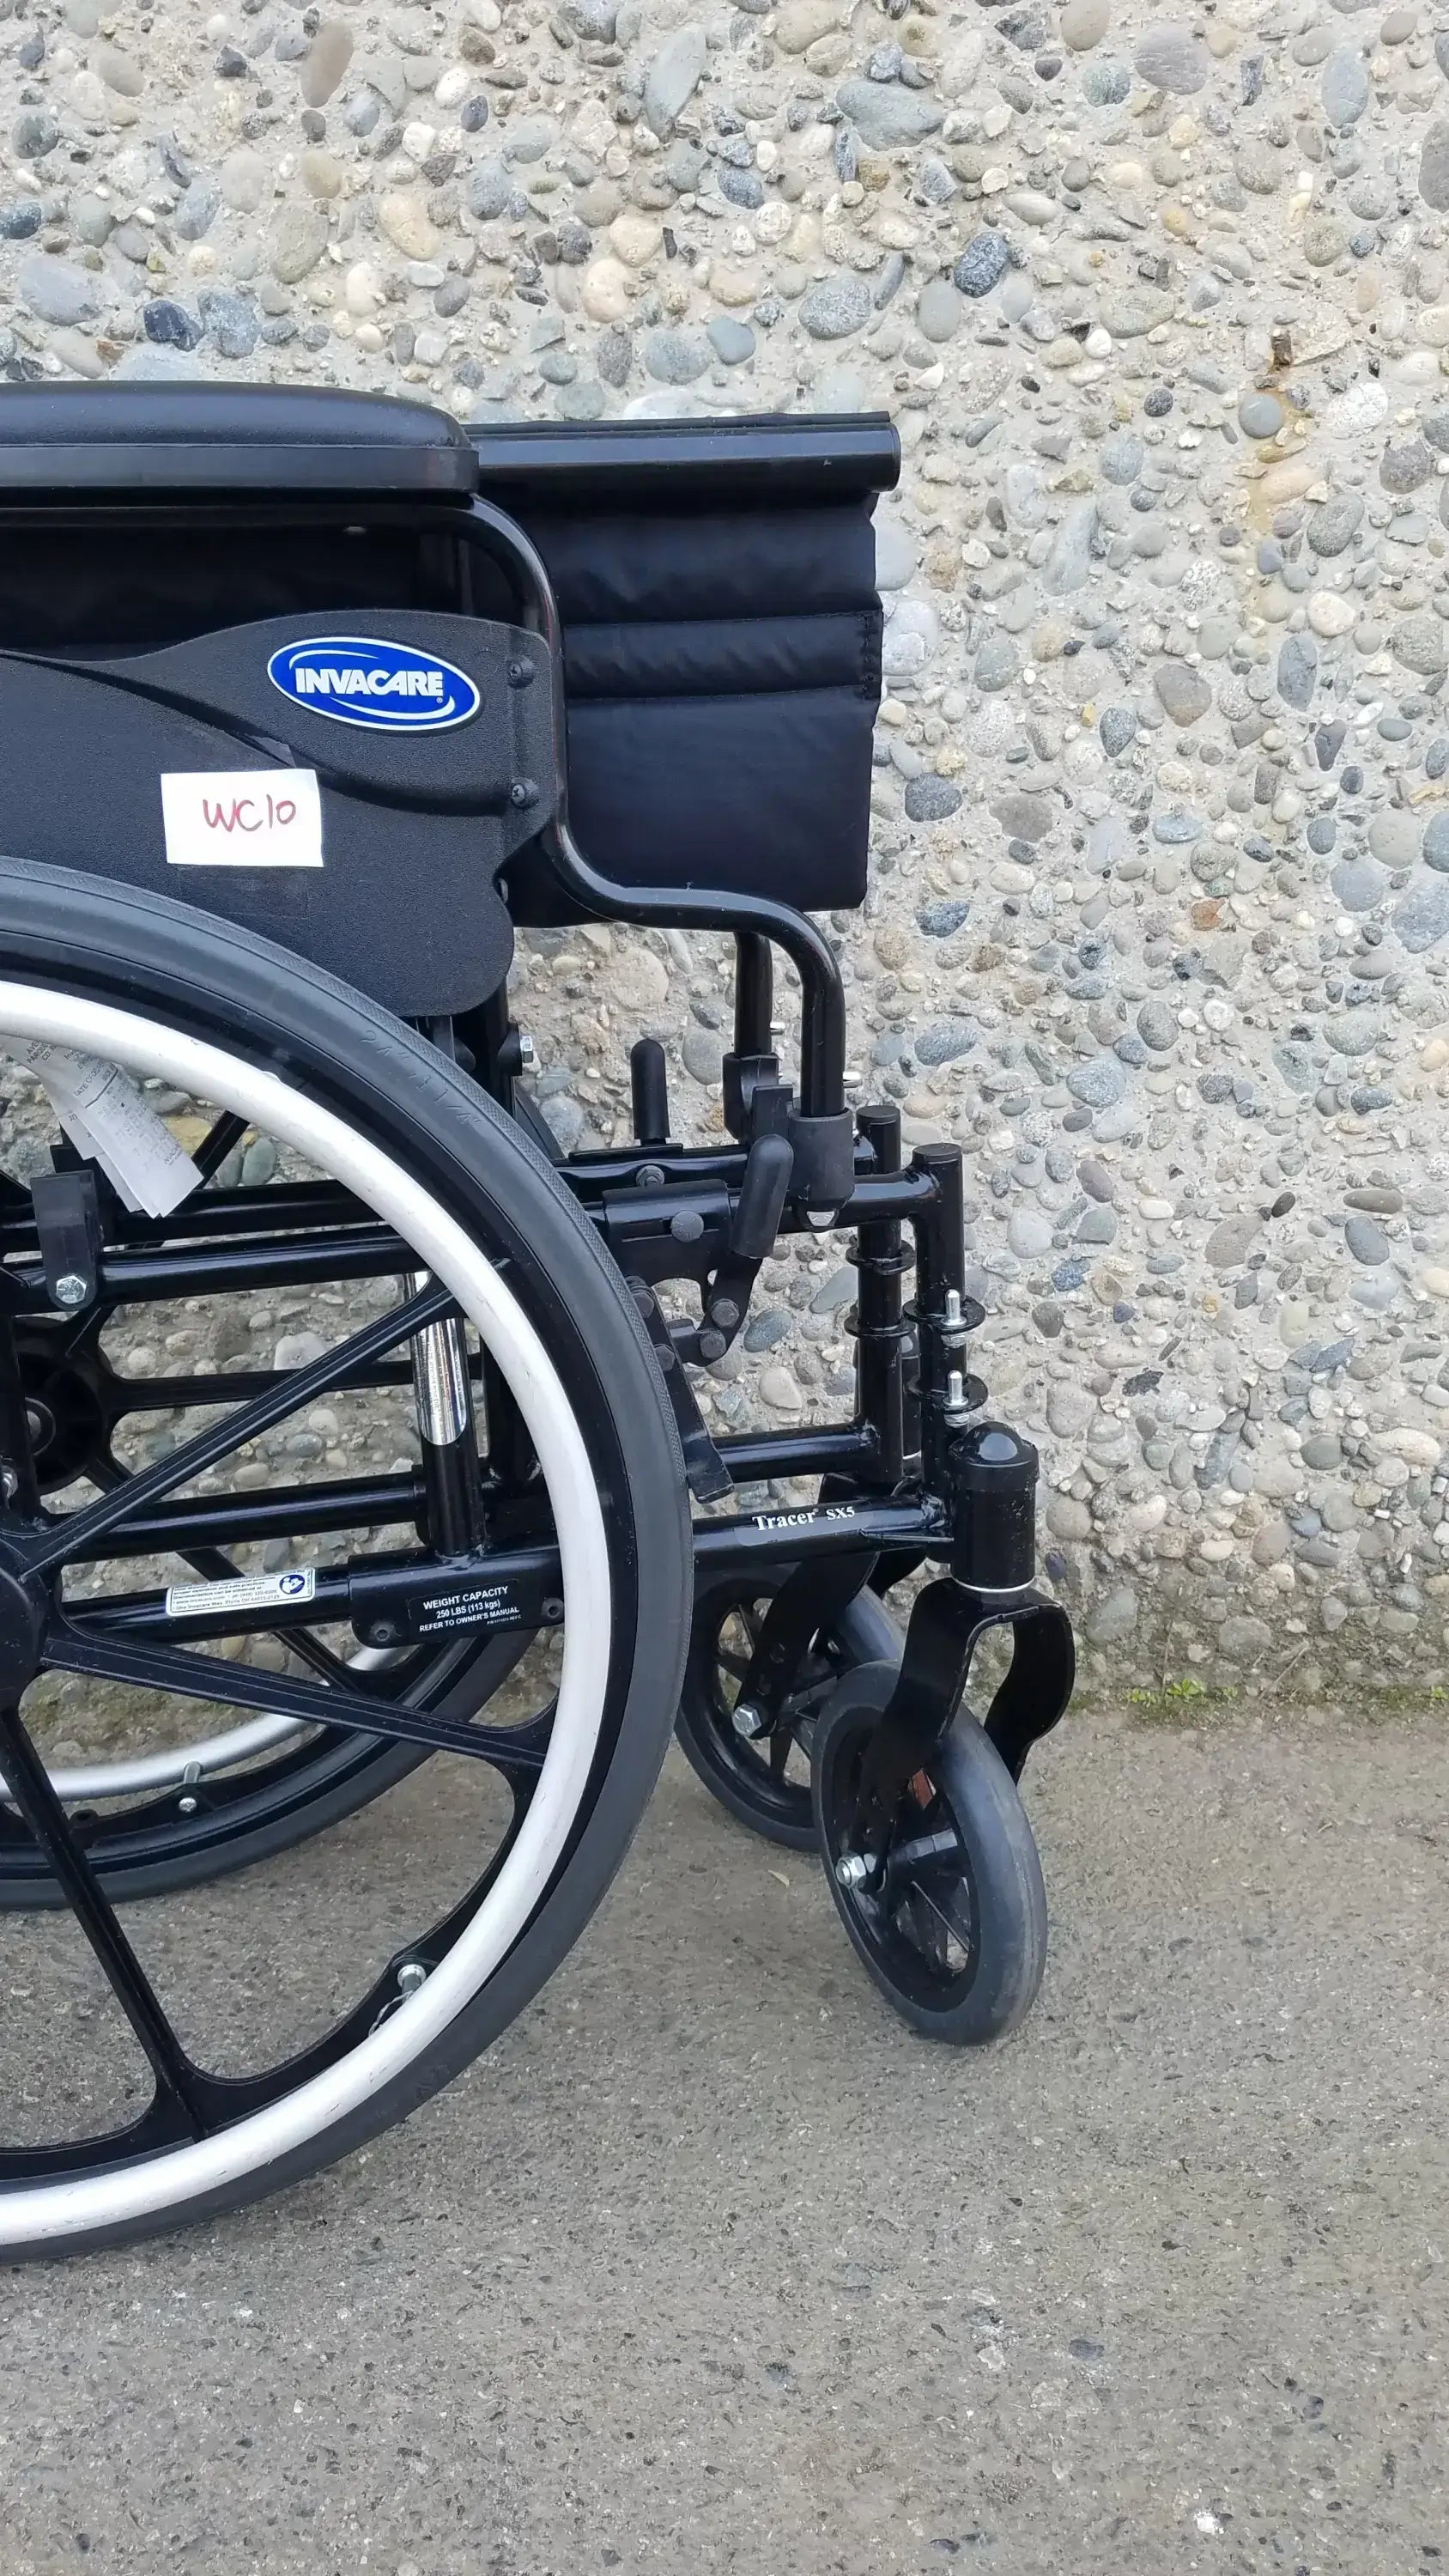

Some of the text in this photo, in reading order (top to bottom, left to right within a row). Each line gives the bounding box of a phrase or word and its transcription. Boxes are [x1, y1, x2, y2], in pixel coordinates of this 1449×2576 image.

[294, 667, 444, 696] INVACARE
[202, 794, 296, 832] WC10
[752, 1506, 855, 1531] Tracer SX5
[423, 1586, 509, 1610] WEIGHT CAPACITY
[436, 1599, 501, 1619] 250 LBS (113 kgs)
[419, 1621, 444, 1632] REFER
[445, 1619, 455, 1627] TO
[456, 1612, 488, 1625] OWNER'S
[489, 1607, 520, 1618] MANUAL
